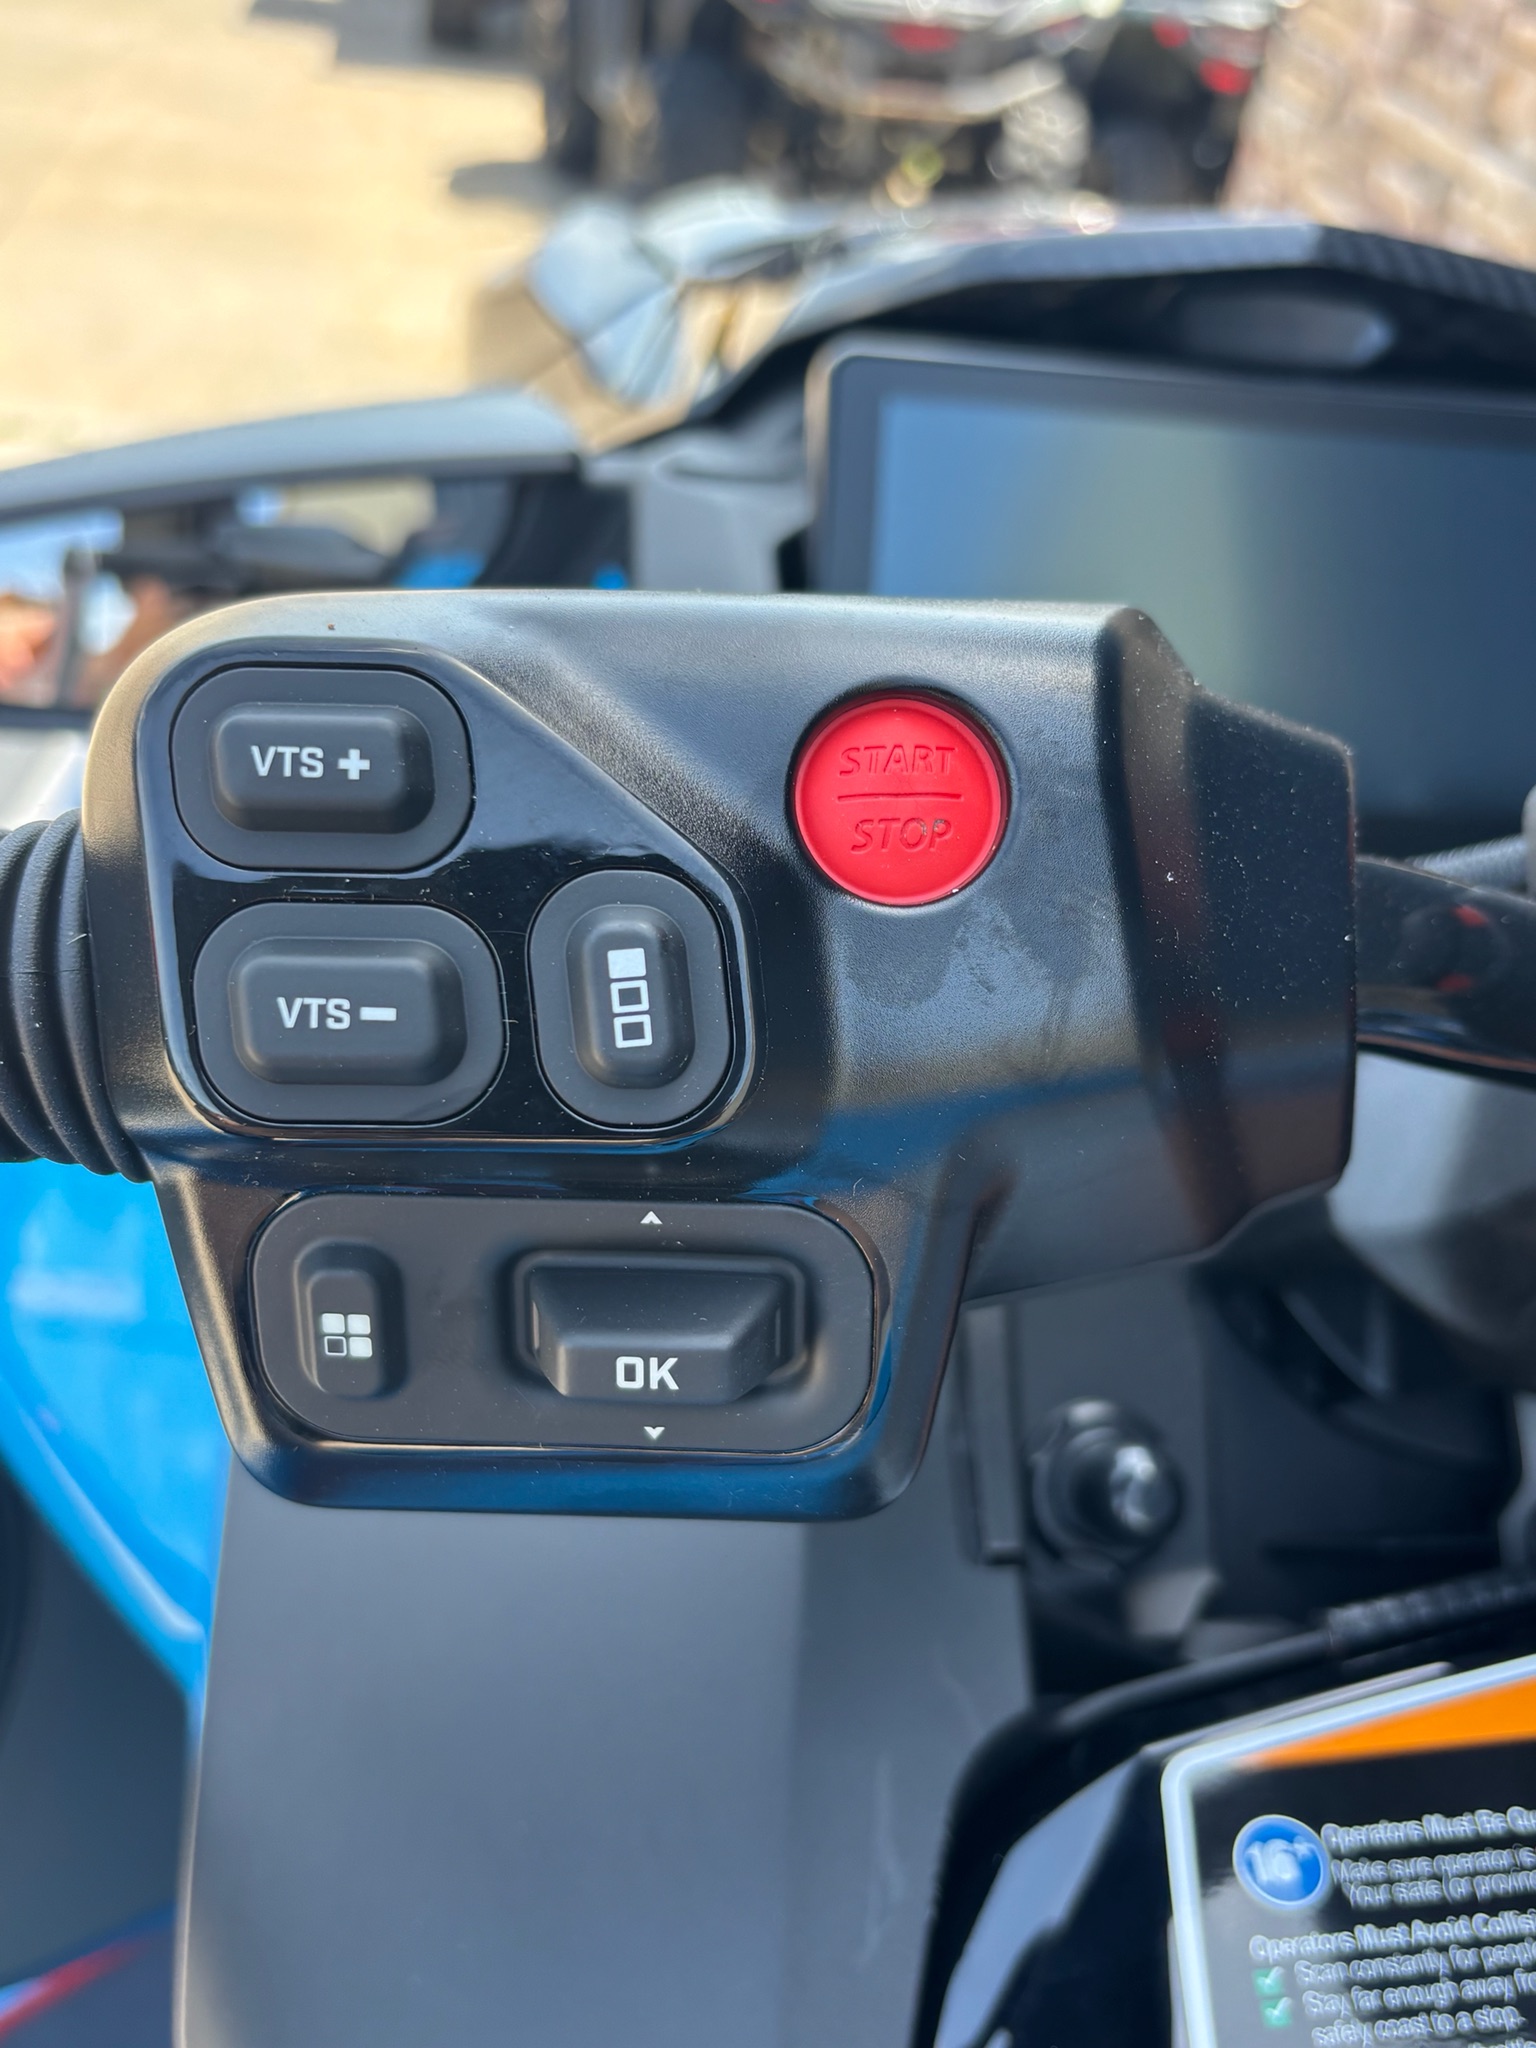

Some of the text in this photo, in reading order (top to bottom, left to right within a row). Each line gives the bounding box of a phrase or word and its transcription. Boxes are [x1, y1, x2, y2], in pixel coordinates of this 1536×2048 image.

[250, 744, 324, 778] VTS
[837, 744, 957, 777] START
[850, 817, 953, 854] STOP
[276, 996, 351, 1030] VTS
[616, 1355, 680, 1390] OK
[1321, 1819, 1423, 1853] Operators
[1422, 1812, 1477, 1840] Must
[1475, 1809, 1508, 1836] Be
[1388, 1856, 1435, 1880] sure
[1434, 1847, 1515, 1877] operator
[1249, 1930, 1356, 1964] Operators
[1354, 1923, 1410, 1950] Must
[1411, 1914, 1472, 1945] Avoid
[1294, 1960, 1348, 1985] Scan
[1349, 1947, 1451, 1980] constantly
[1449, 1944, 1480, 1970] for
[1382, 1977, 1459, 2010] enough
[1460, 1974, 1515, 2002] away
[1373, 2011, 1433, 2041] coast
[1430, 2010, 1455, 2037] to
[1455, 2011, 1474, 2033] a
